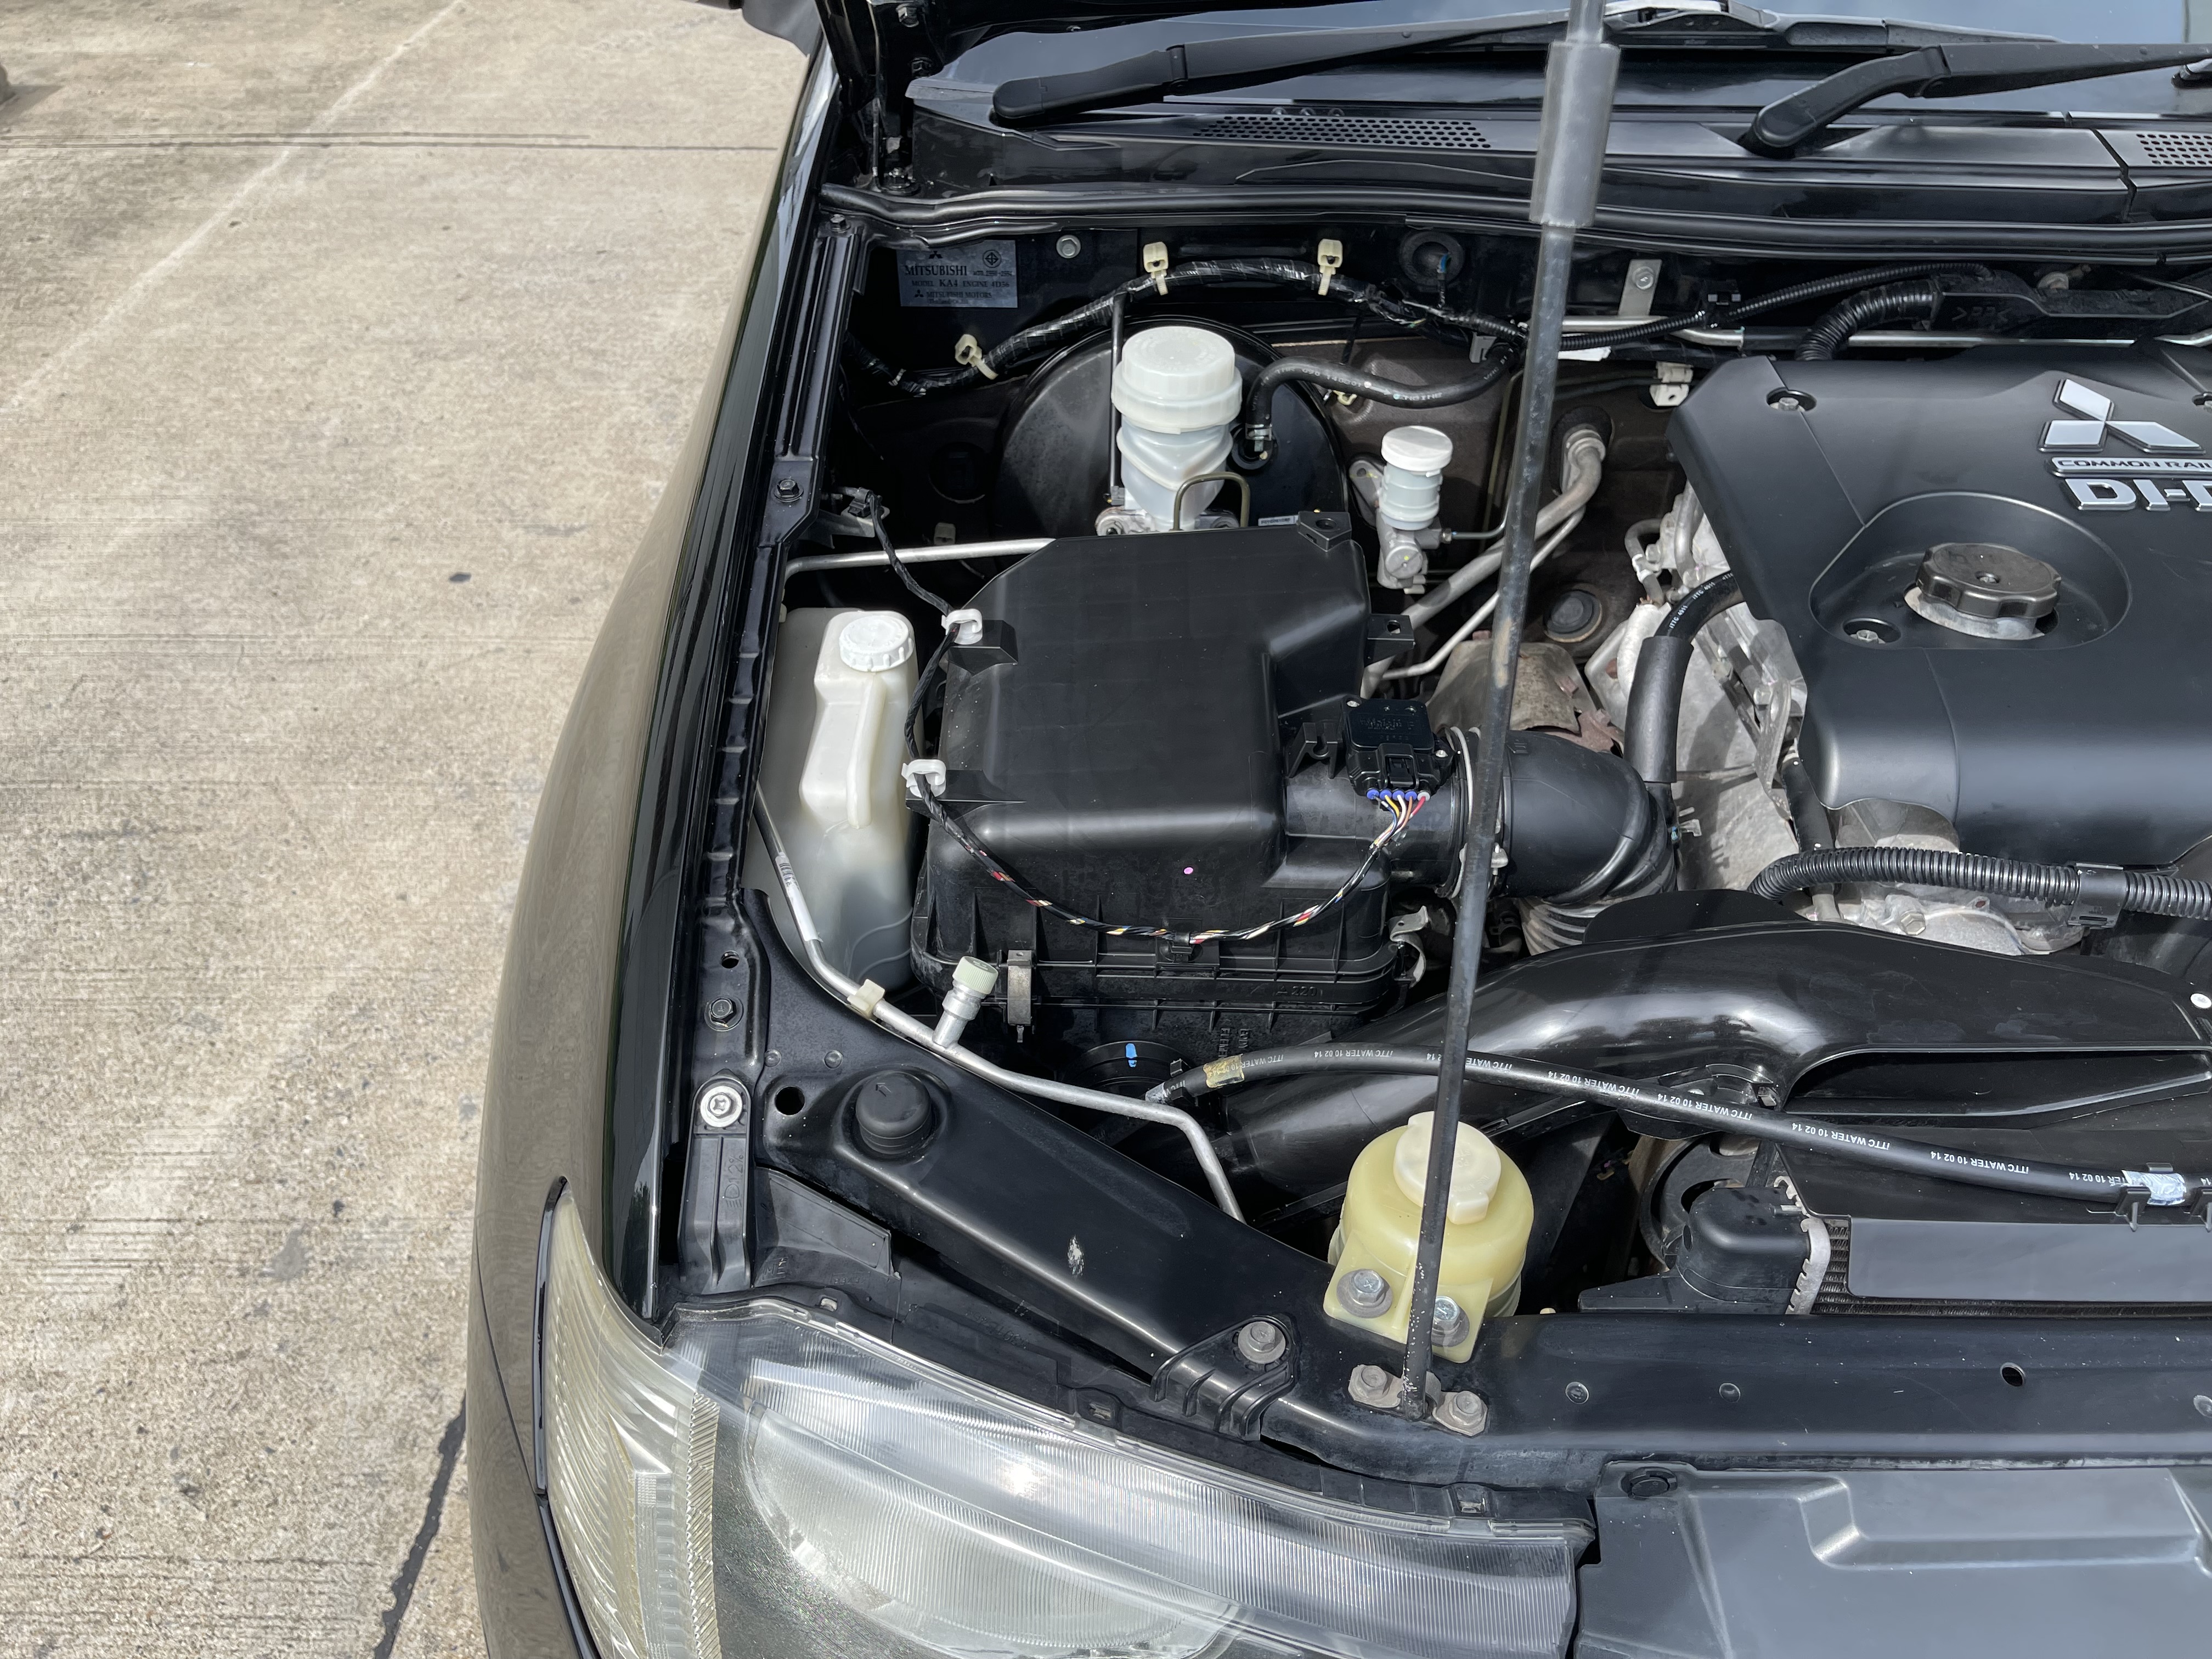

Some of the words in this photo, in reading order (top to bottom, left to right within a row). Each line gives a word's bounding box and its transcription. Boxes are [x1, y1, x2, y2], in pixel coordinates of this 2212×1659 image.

[905, 266, 967, 276] MITSUBISHI
[1346, 1049, 1373, 1057] WATER
[1240, 1058, 1267, 1068] WATER
[1466, 1057, 1491, 1069] WATE
[1548, 1070, 1557, 1079] 14
[1572, 1075, 1582, 1084] 10
[1584, 1077, 1617, 1092] WATER
[1657, 1093, 1668, 1102] 14
[1670, 1096, 1680, 1105] 02
[1695, 1101, 1729, 1116] WATER
[1792, 1122, 1802, 1132] 14
[1805, 1125, 1816, 1135] 02
[1818, 1128, 1829, 1137] 10
[1831, 1131, 1866, 1146] WATER
[1931, 1151, 1942, 1160] 14
[1944, 1153, 1955, 1163] 02
[1957, 1155, 1968, 1165] 10
[1970, 1158, 2006, 1171] WATER
[2069, 1172, 2080, 1181] 14
[2082, 1173, 2093, 1182] 02
[2095, 1175, 2106, 1183] 10
